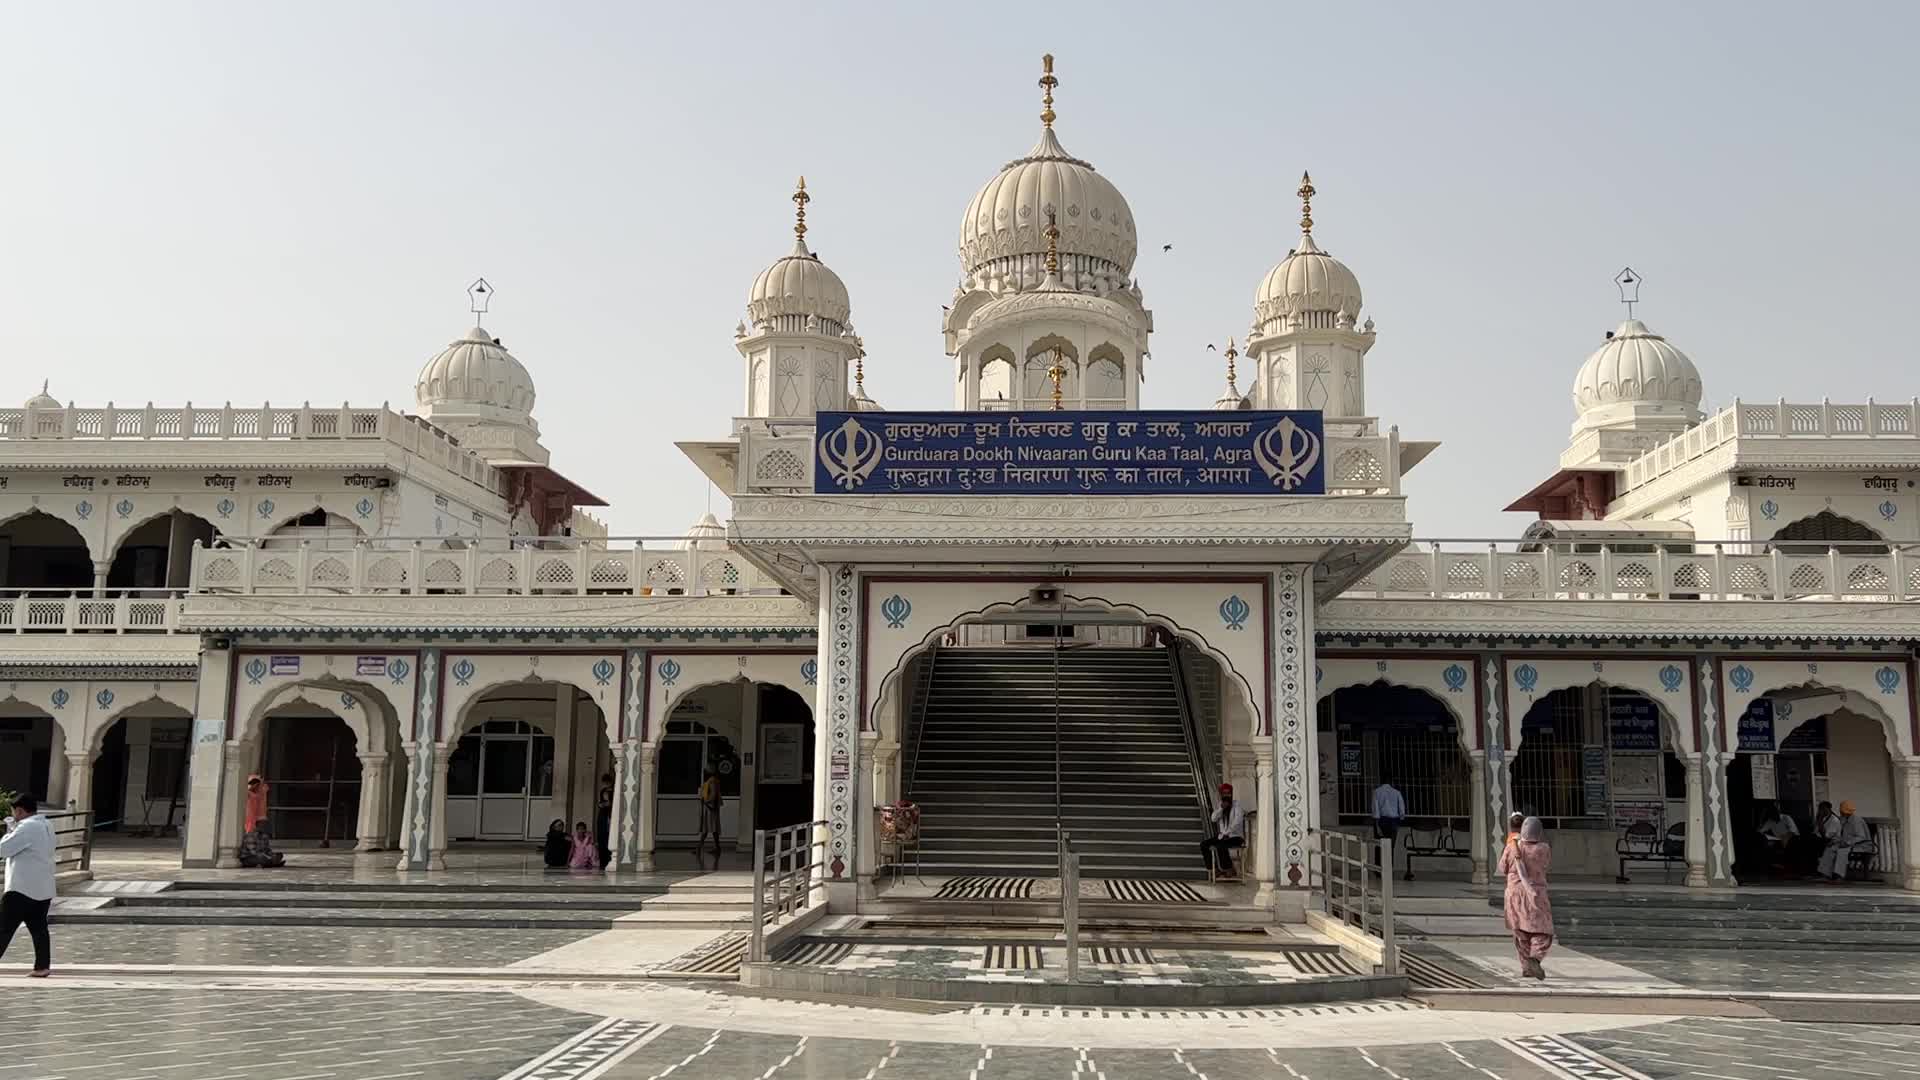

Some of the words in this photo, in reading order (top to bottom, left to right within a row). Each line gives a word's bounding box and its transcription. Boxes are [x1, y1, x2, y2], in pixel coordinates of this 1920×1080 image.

[885, 423, 966, 442] ਗੁਰਦੁਆਰਾ
[973, 423, 1001, 445] ਦੂਖ
[1008, 416, 1074, 438] ਨਿਵਾਰਣ
[1081, 422, 1110, 444] ਗੁਰੂ
[1117, 422, 1139, 438] ਕਾ
[1145, 422, 1186, 440] ਤਾਲ,
[1194, 422, 1252, 438] ਆਗਰਾ
[884, 446, 959, 461] Gurduara
[963, 446, 1013, 461] Dookh
[1018, 446, 1088, 461] Nivaaran
[1092, 446, 1131, 461] Guru
[1136, 446, 1167, 461] Kaa
[1170, 446, 1209, 463] Taal,
[1213, 446, 1252, 464] Agra
[884, 468, 952, 490] गुरूद्वारा
[1003, 462, 1070, 484] निवारण
[1075, 468, 1109, 489] गुरू
[1113, 468, 1140, 484] का
[1196, 468, 1252, 484] आगरा
